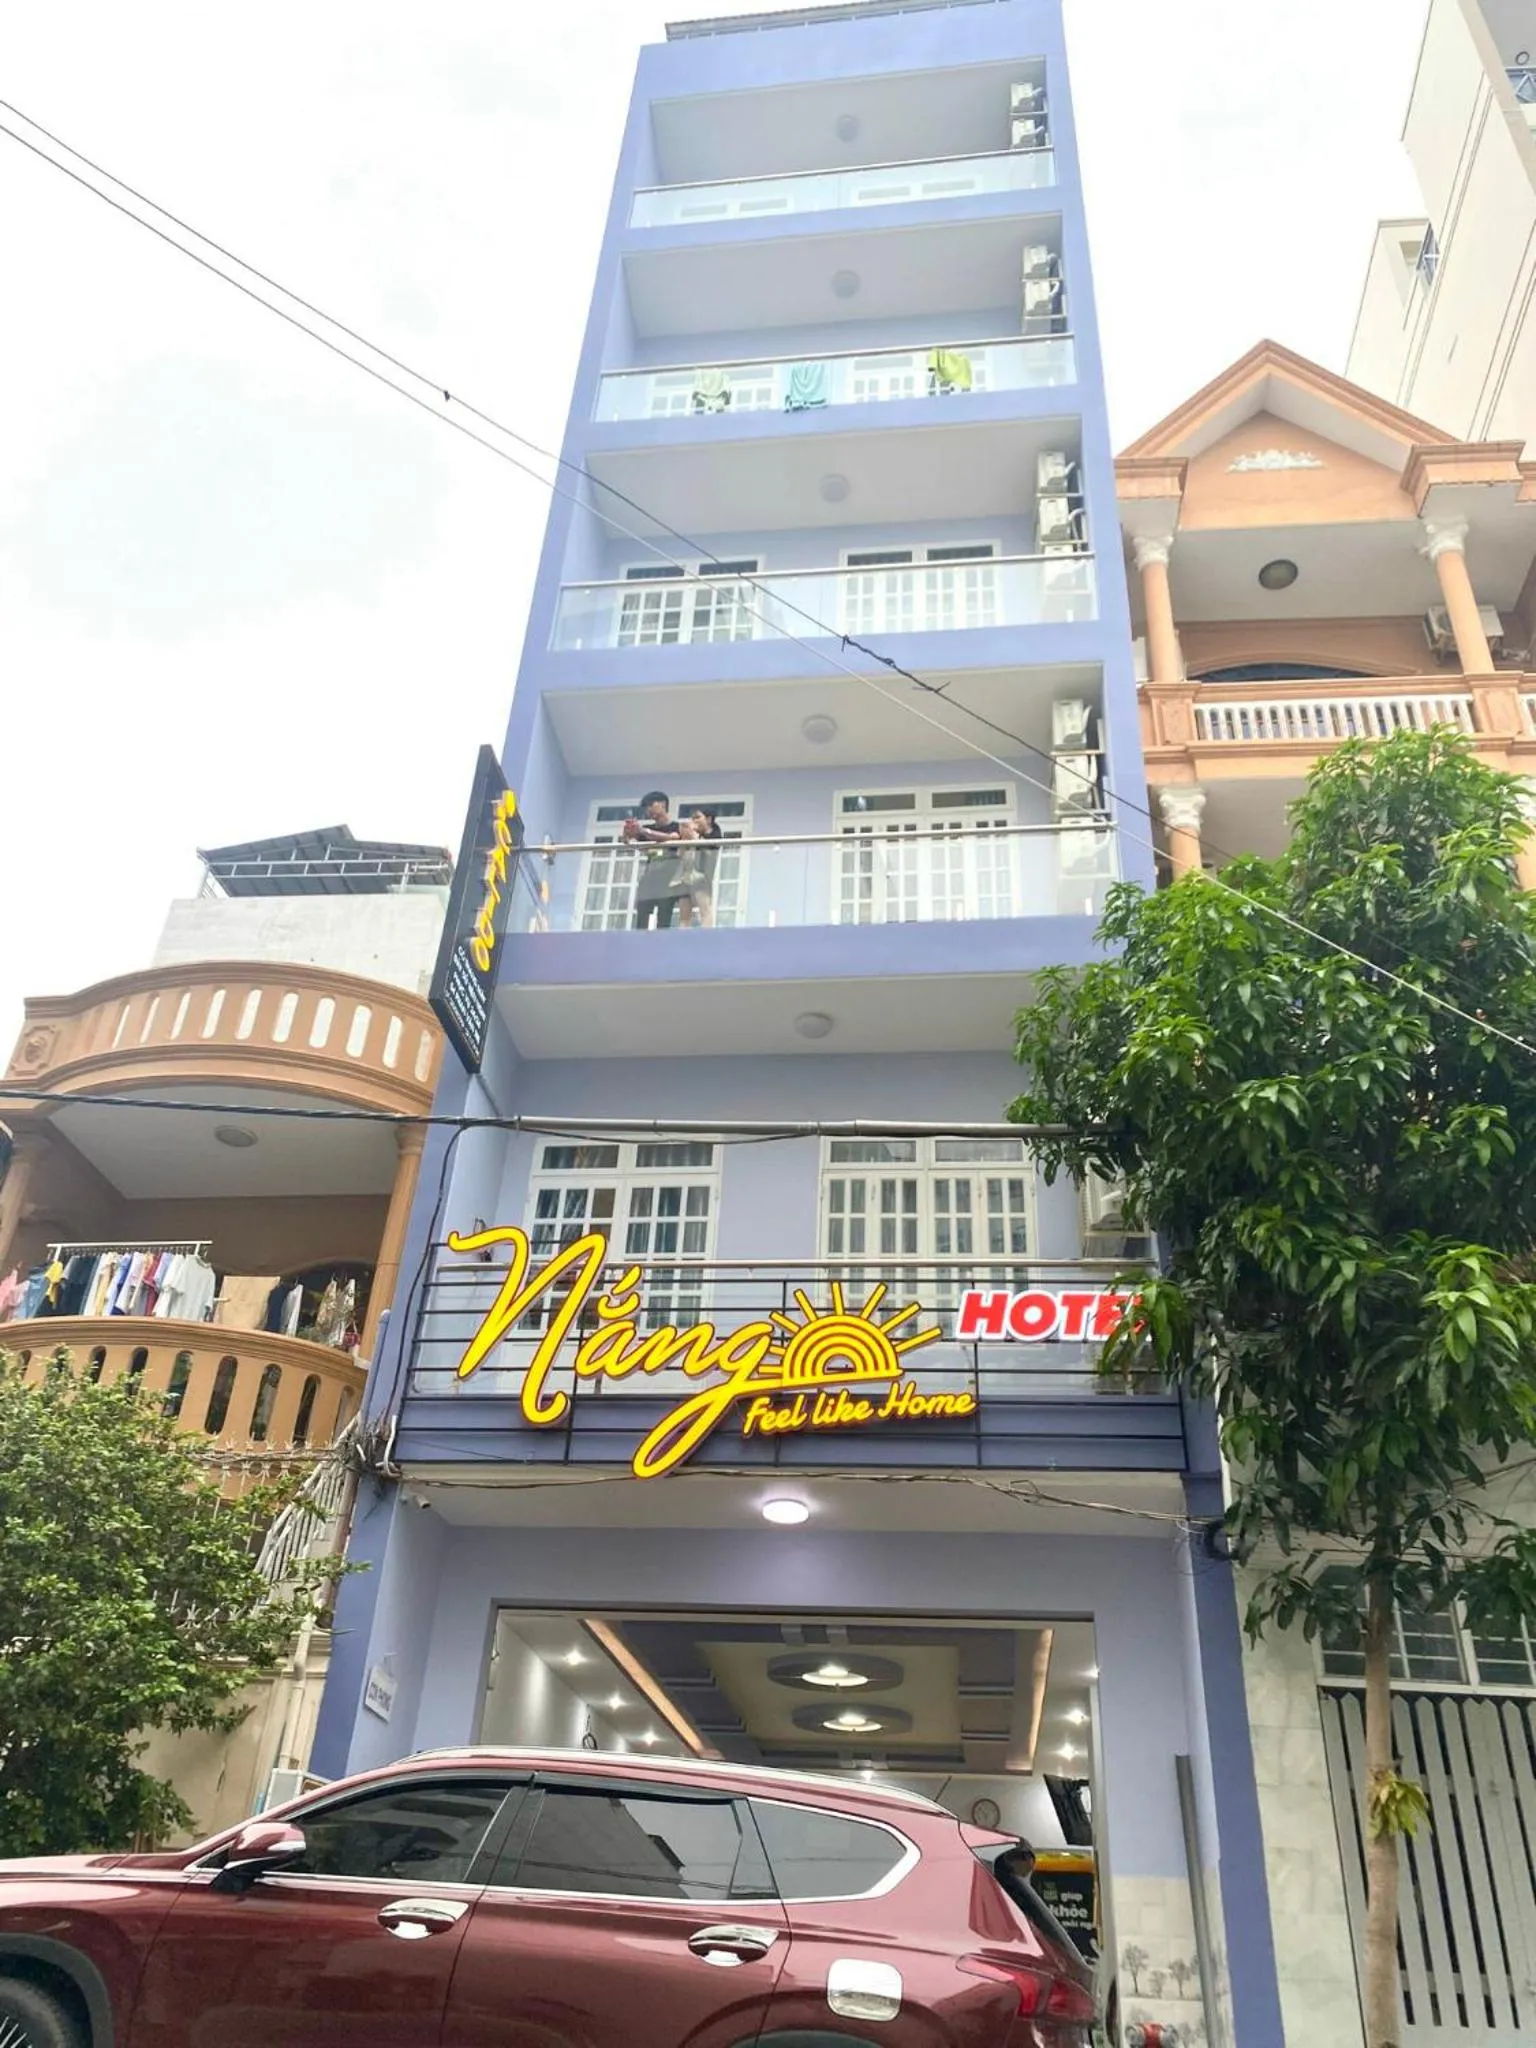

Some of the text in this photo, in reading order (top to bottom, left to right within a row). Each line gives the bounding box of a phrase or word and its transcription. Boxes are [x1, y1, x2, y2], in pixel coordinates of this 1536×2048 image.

[448, 1226, 774, 1479] Nắng
[811, 1389, 875, 1426] like
[877, 1380, 977, 1419] Home
